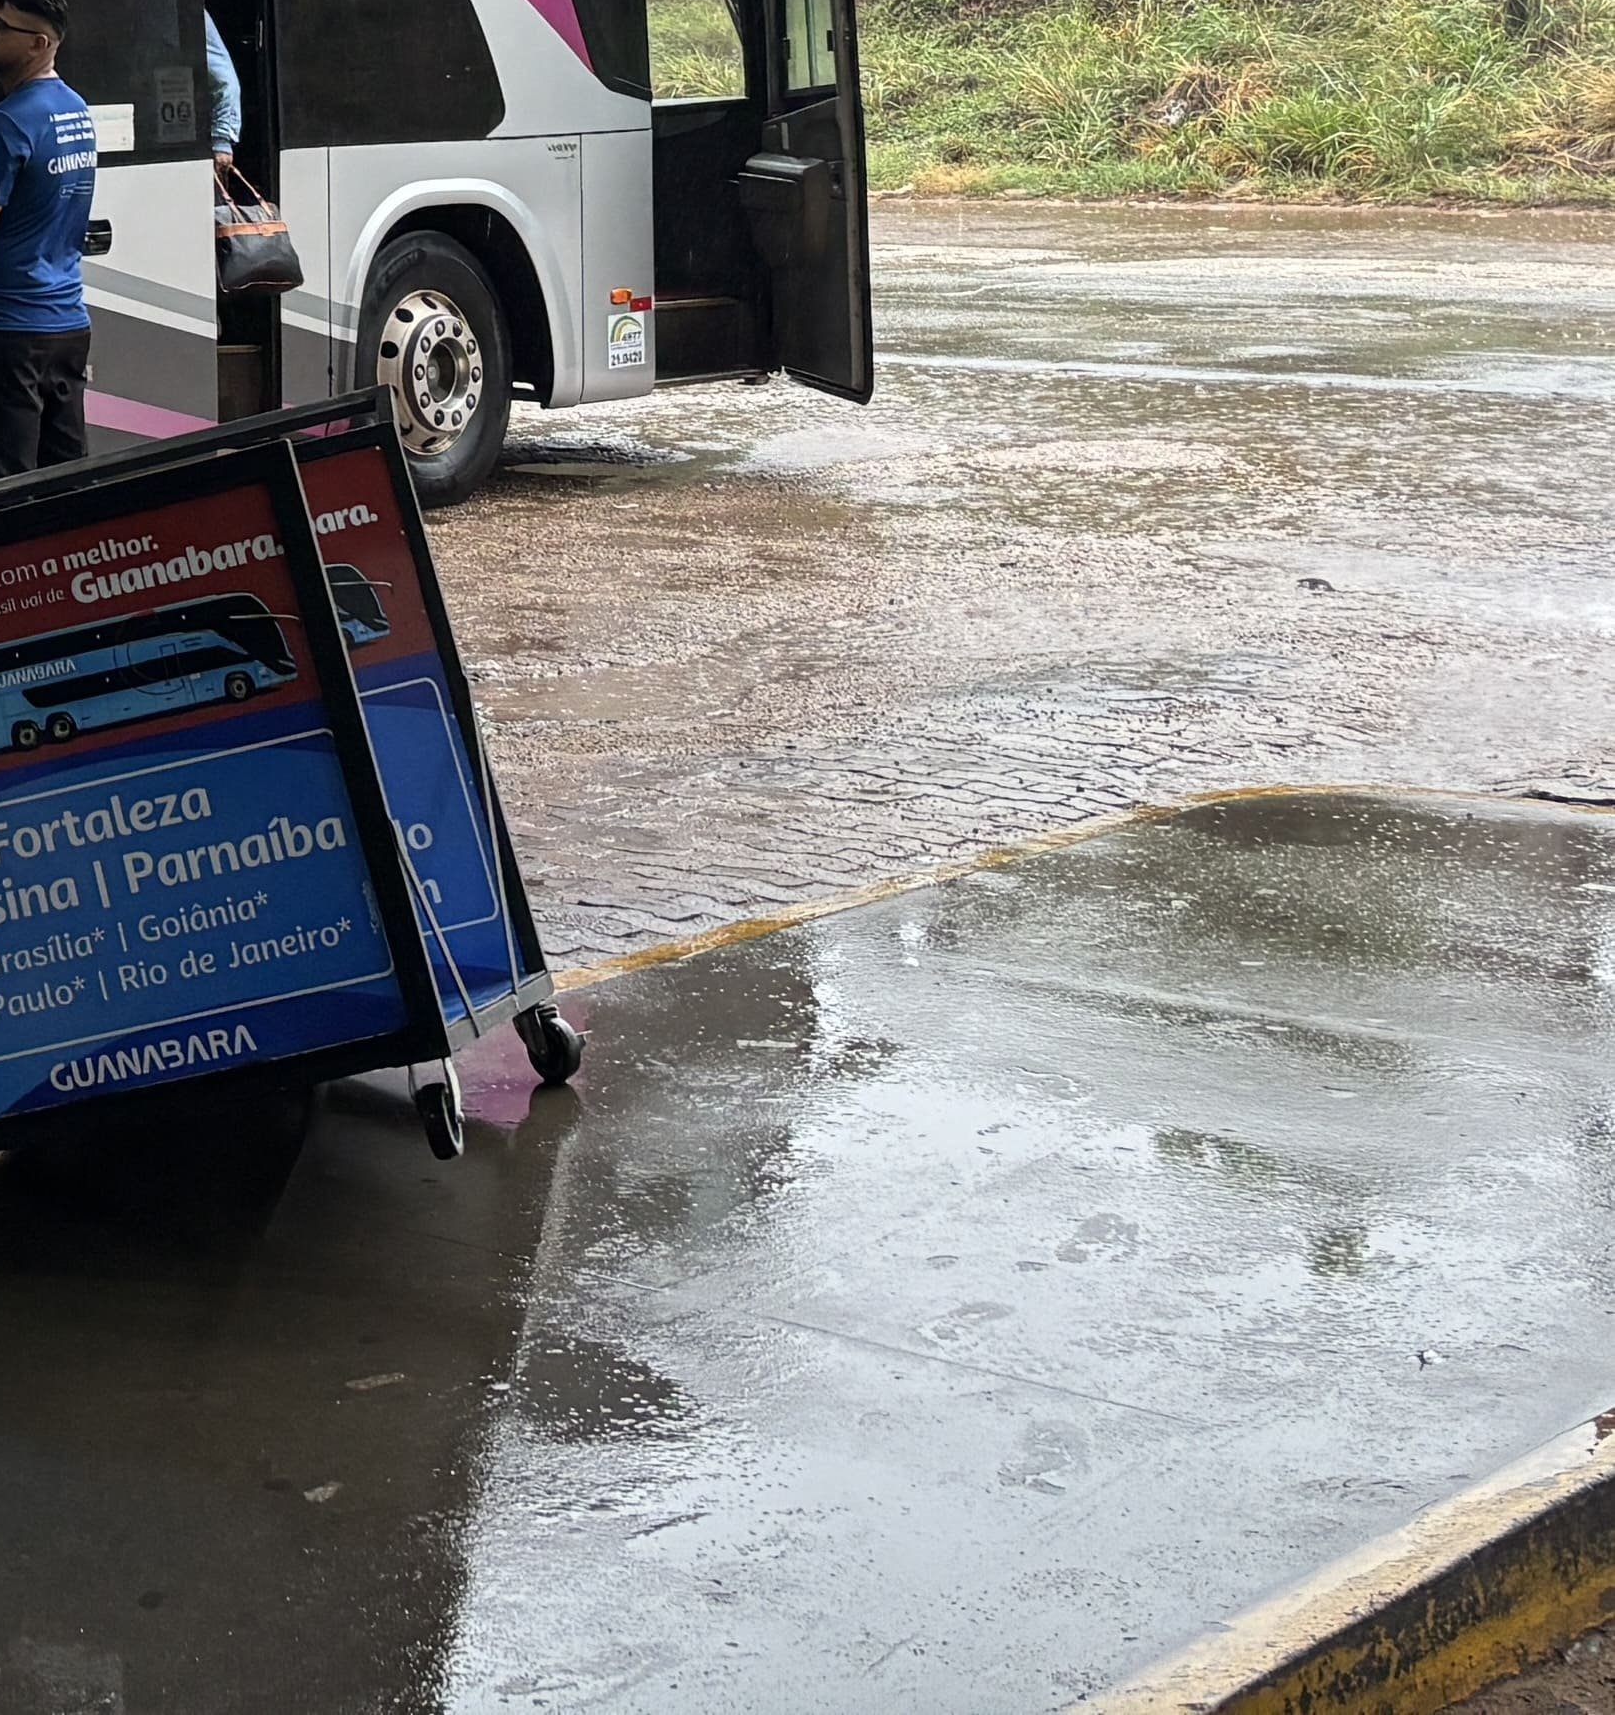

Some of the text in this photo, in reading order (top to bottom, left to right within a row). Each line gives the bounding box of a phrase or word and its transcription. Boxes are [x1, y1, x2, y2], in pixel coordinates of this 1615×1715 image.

[20, 591, 44, 611] vai
[46, 585, 65, 605] de
[70, 534, 284, 604] Guanabara.
[41, 559, 59, 578] a
[63, 533, 159, 572] melhor.
[122, 813, 347, 894] Parnaíba
[118, 961, 169, 994] Rio
[178, 947, 218, 978] de
[49, 1024, 259, 1093] GUANABARA
